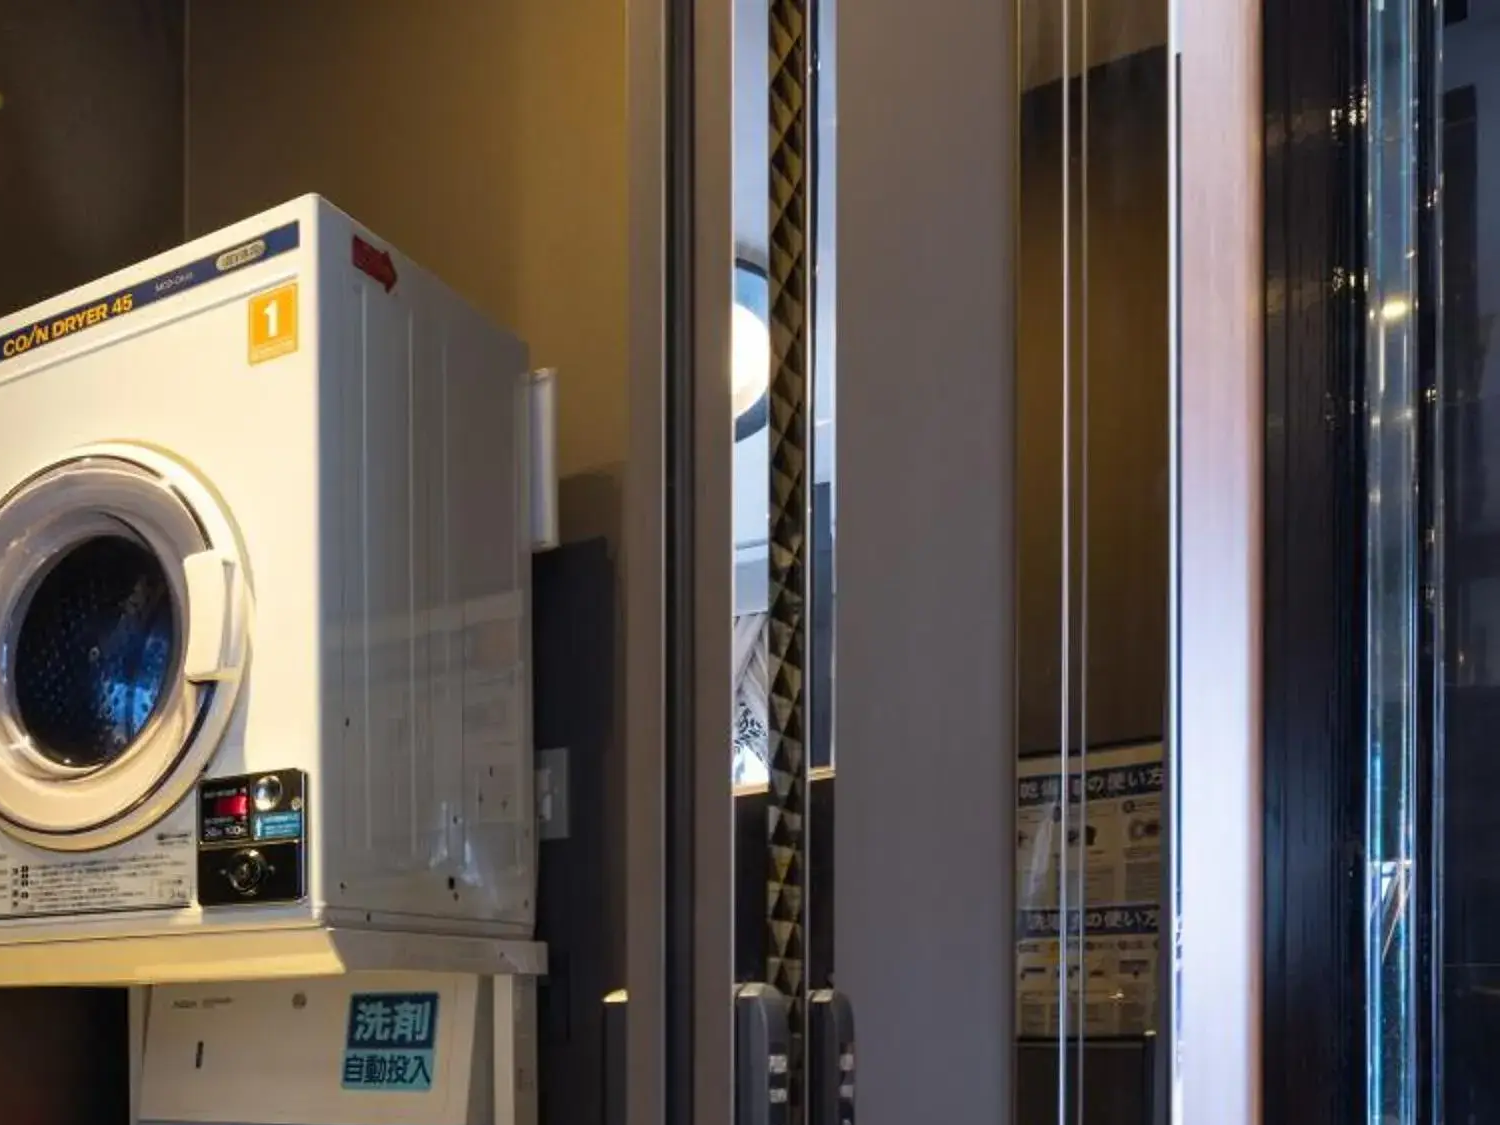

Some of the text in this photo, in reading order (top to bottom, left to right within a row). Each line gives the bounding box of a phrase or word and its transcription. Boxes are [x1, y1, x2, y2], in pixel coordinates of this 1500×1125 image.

[51, 303, 108, 338] DRYER
[112, 293, 133, 315] 45
[263, 299, 278, 337] 1
[354, 1001, 431, 1041] 洗剤
[343, 1053, 431, 1086] 自動投入
